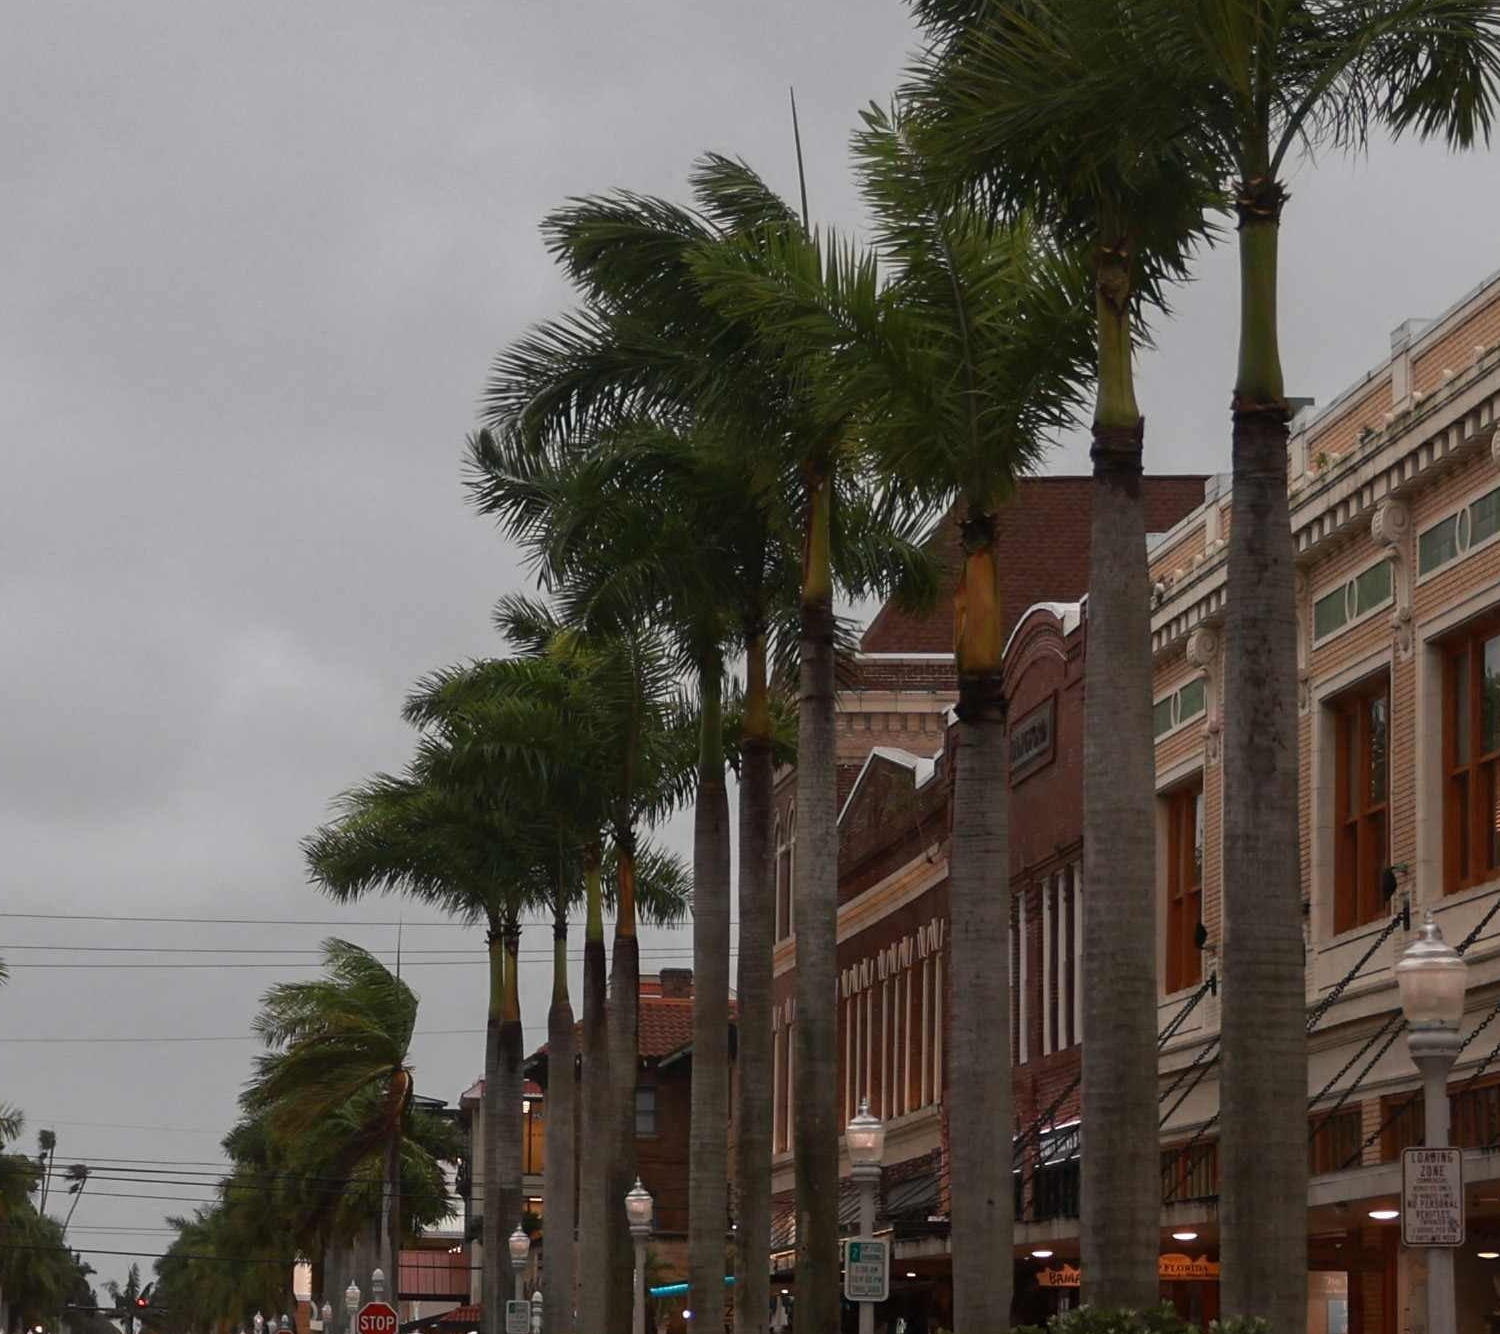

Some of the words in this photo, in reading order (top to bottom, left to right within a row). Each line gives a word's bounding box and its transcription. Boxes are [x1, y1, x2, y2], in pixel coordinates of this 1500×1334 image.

[1411, 1152, 1454, 1163] LOADING
[1420, 1165, 1445, 1177] ZONE
[360, 1315, 395, 1331] STOP
